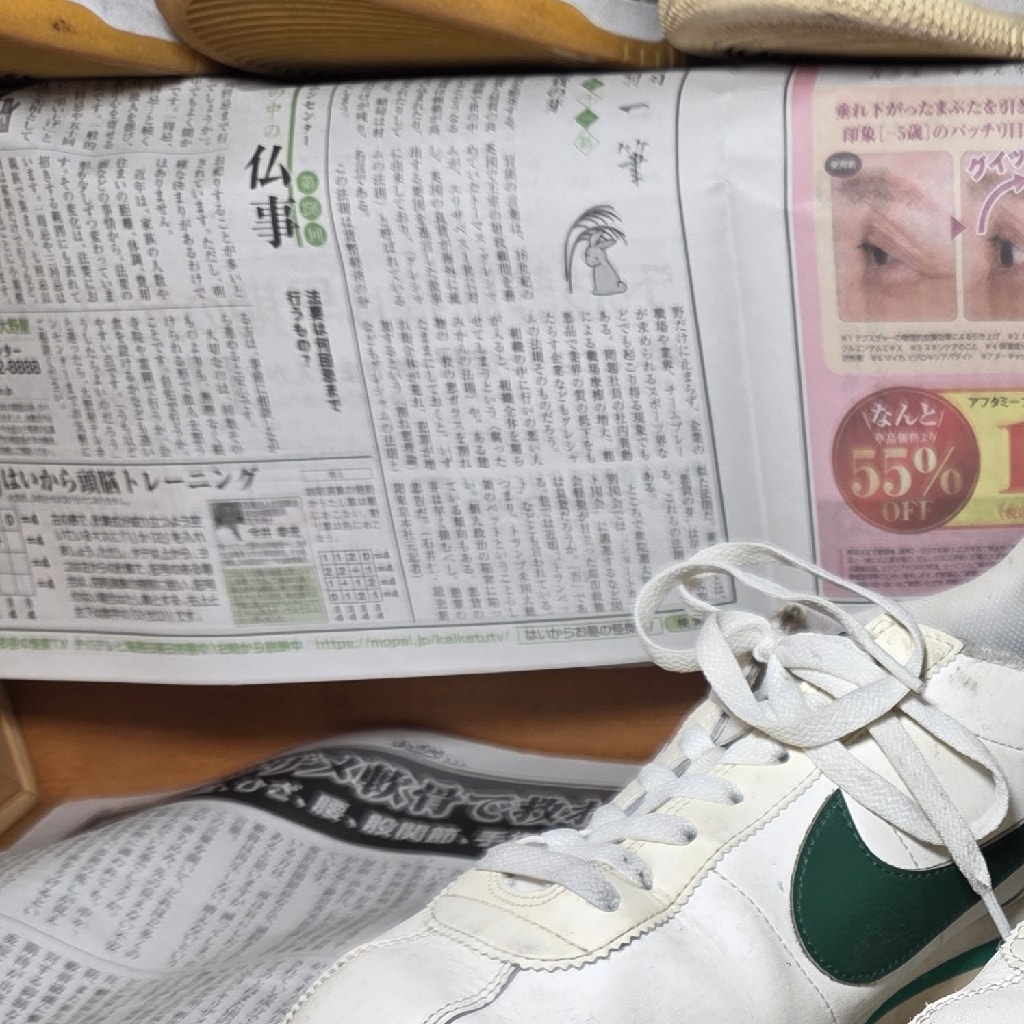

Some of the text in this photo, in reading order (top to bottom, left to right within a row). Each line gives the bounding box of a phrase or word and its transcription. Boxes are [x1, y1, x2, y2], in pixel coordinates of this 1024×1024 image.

[244, 144, 299, 249] 仏事
[870, 403, 940, 427] なんと
[3, 466, 260, 496] はいから頭脳トレーニング
[850, 446, 962, 498] 55%
[881, 501, 930, 521] OFF
